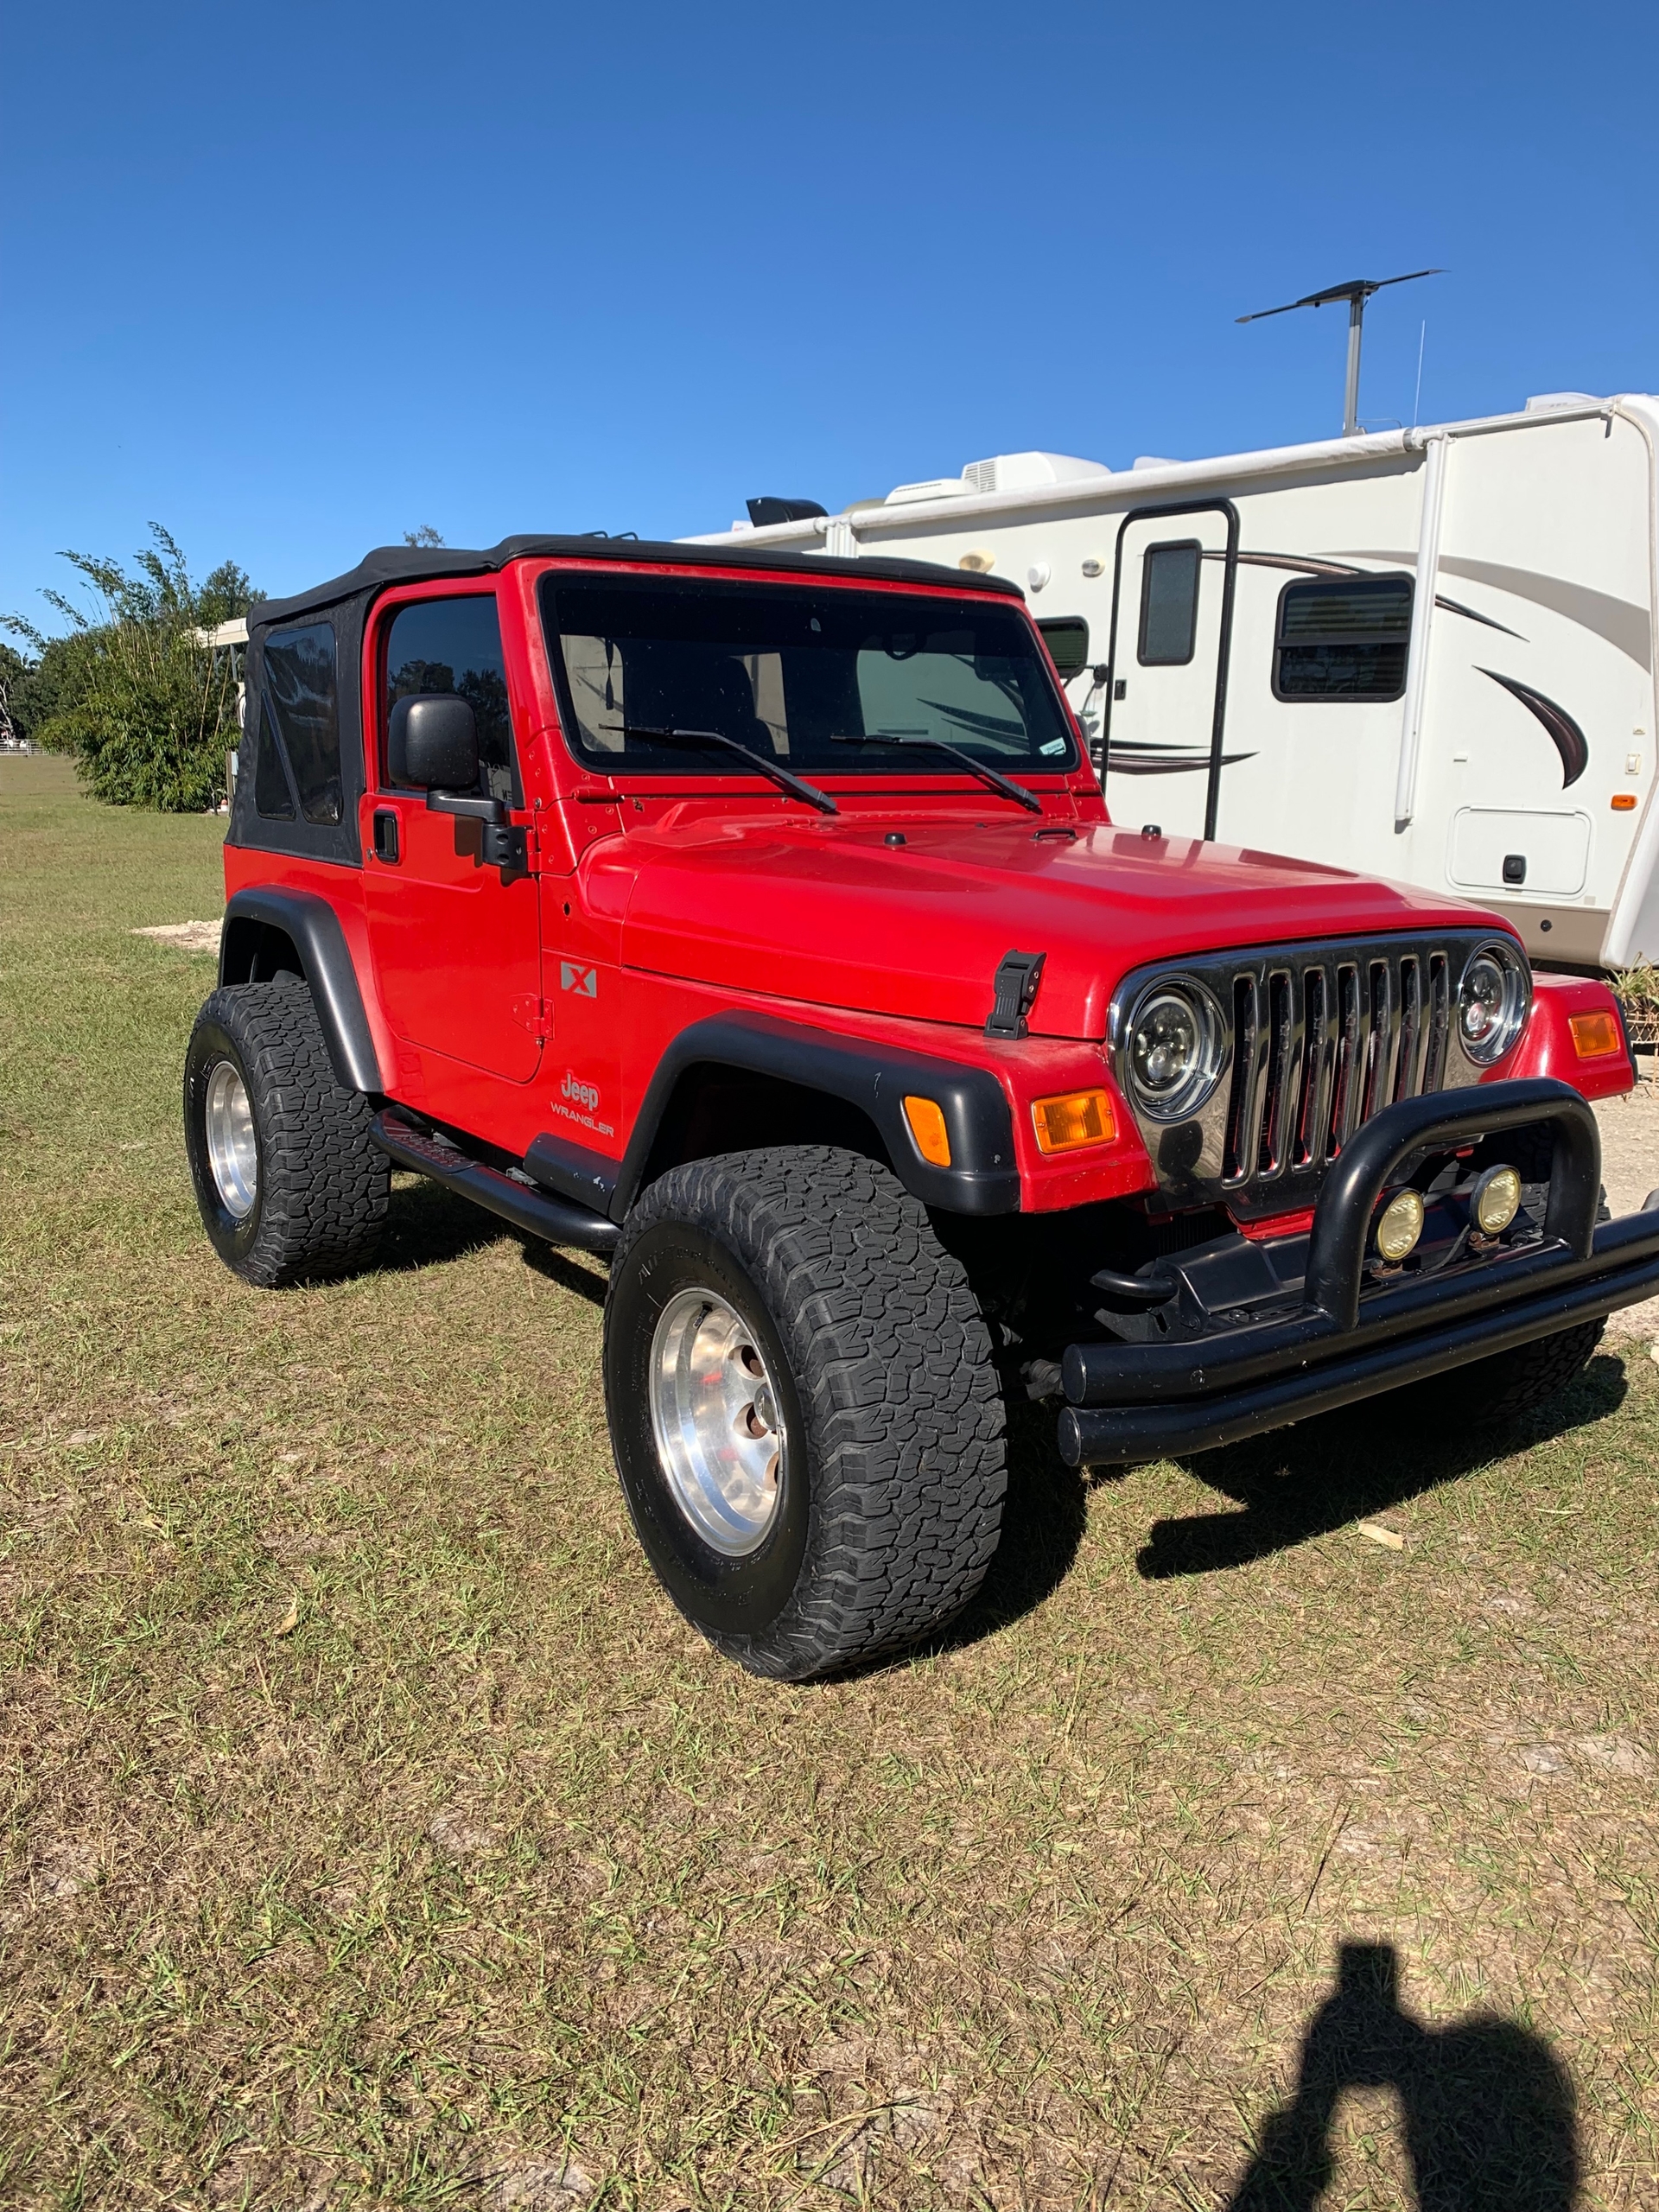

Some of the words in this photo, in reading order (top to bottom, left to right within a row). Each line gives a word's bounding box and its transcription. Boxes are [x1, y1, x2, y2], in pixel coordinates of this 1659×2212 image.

[563, 963, 595, 995] X
[561, 1072, 599, 1112] Jeep
[550, 1101, 614, 1137] WRANGLER
